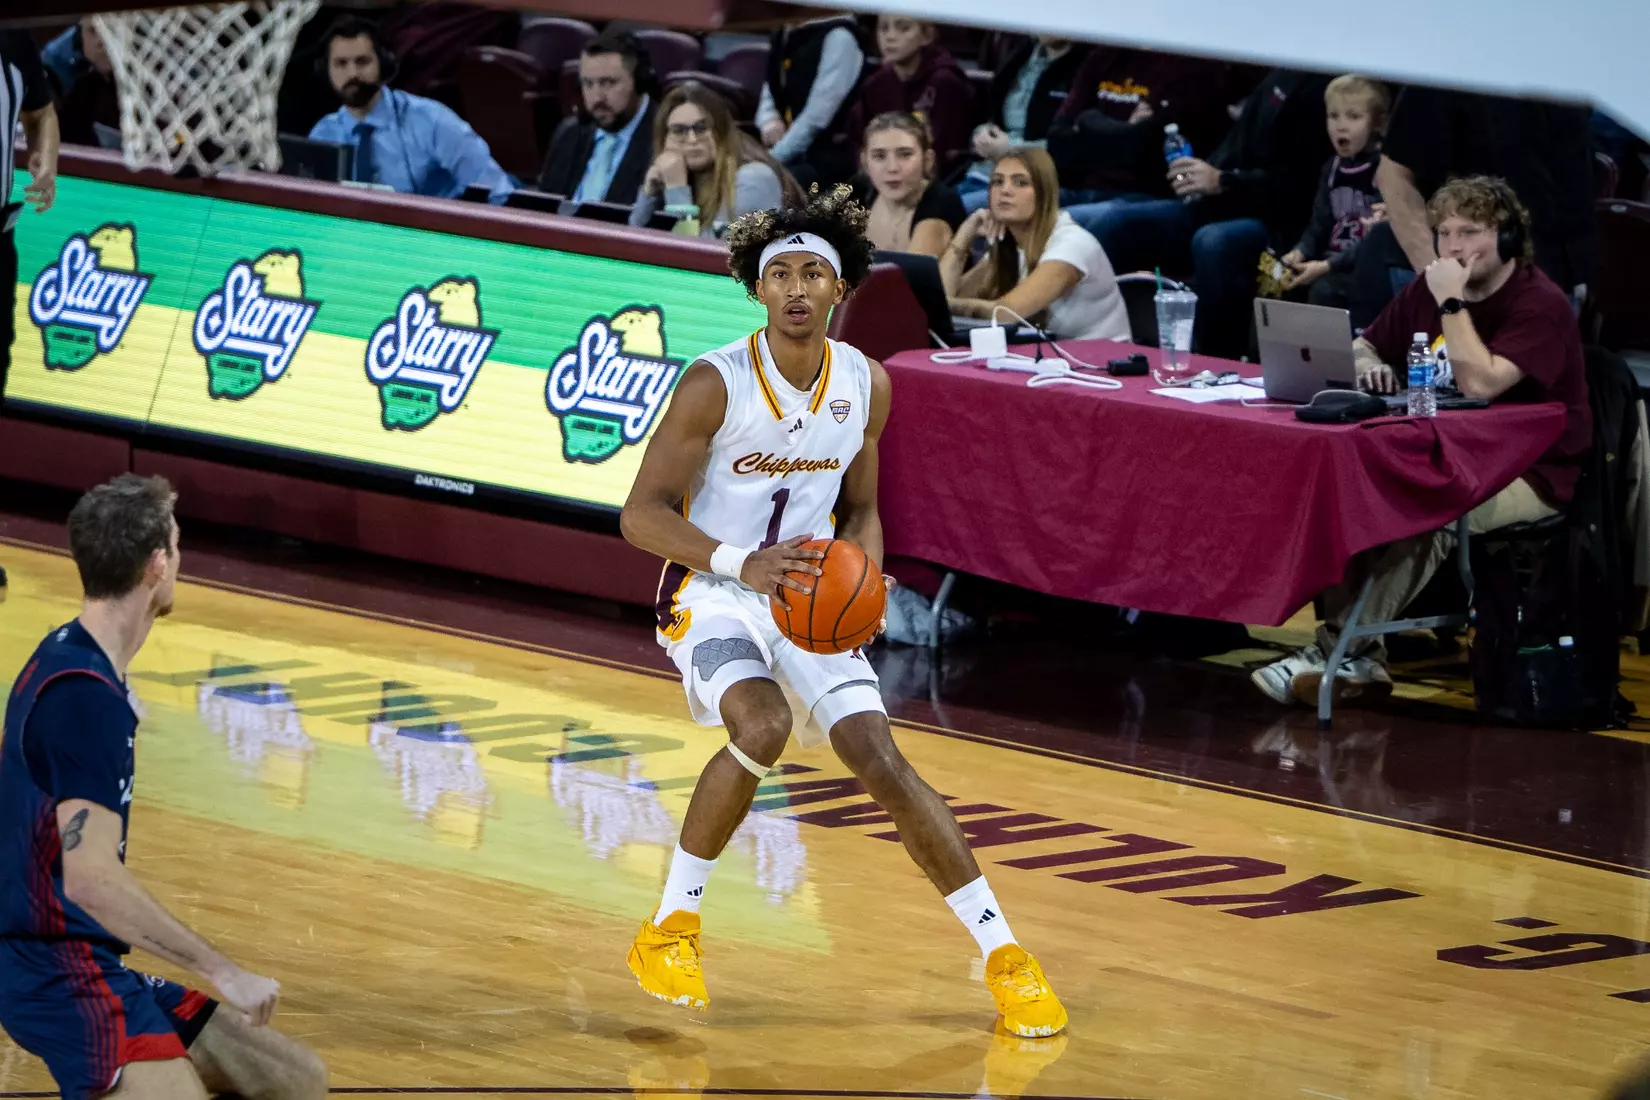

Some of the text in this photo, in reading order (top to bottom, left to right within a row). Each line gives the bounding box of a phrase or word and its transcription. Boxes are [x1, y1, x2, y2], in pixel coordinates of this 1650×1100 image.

[31, 236, 149, 350] Starry
[195, 263, 317, 378] Starry
[367, 291, 494, 409] Starry
[547, 319, 680, 440] Starry
[732, 452, 841, 479] Chippewas
[758, 487, 790, 551] 1
